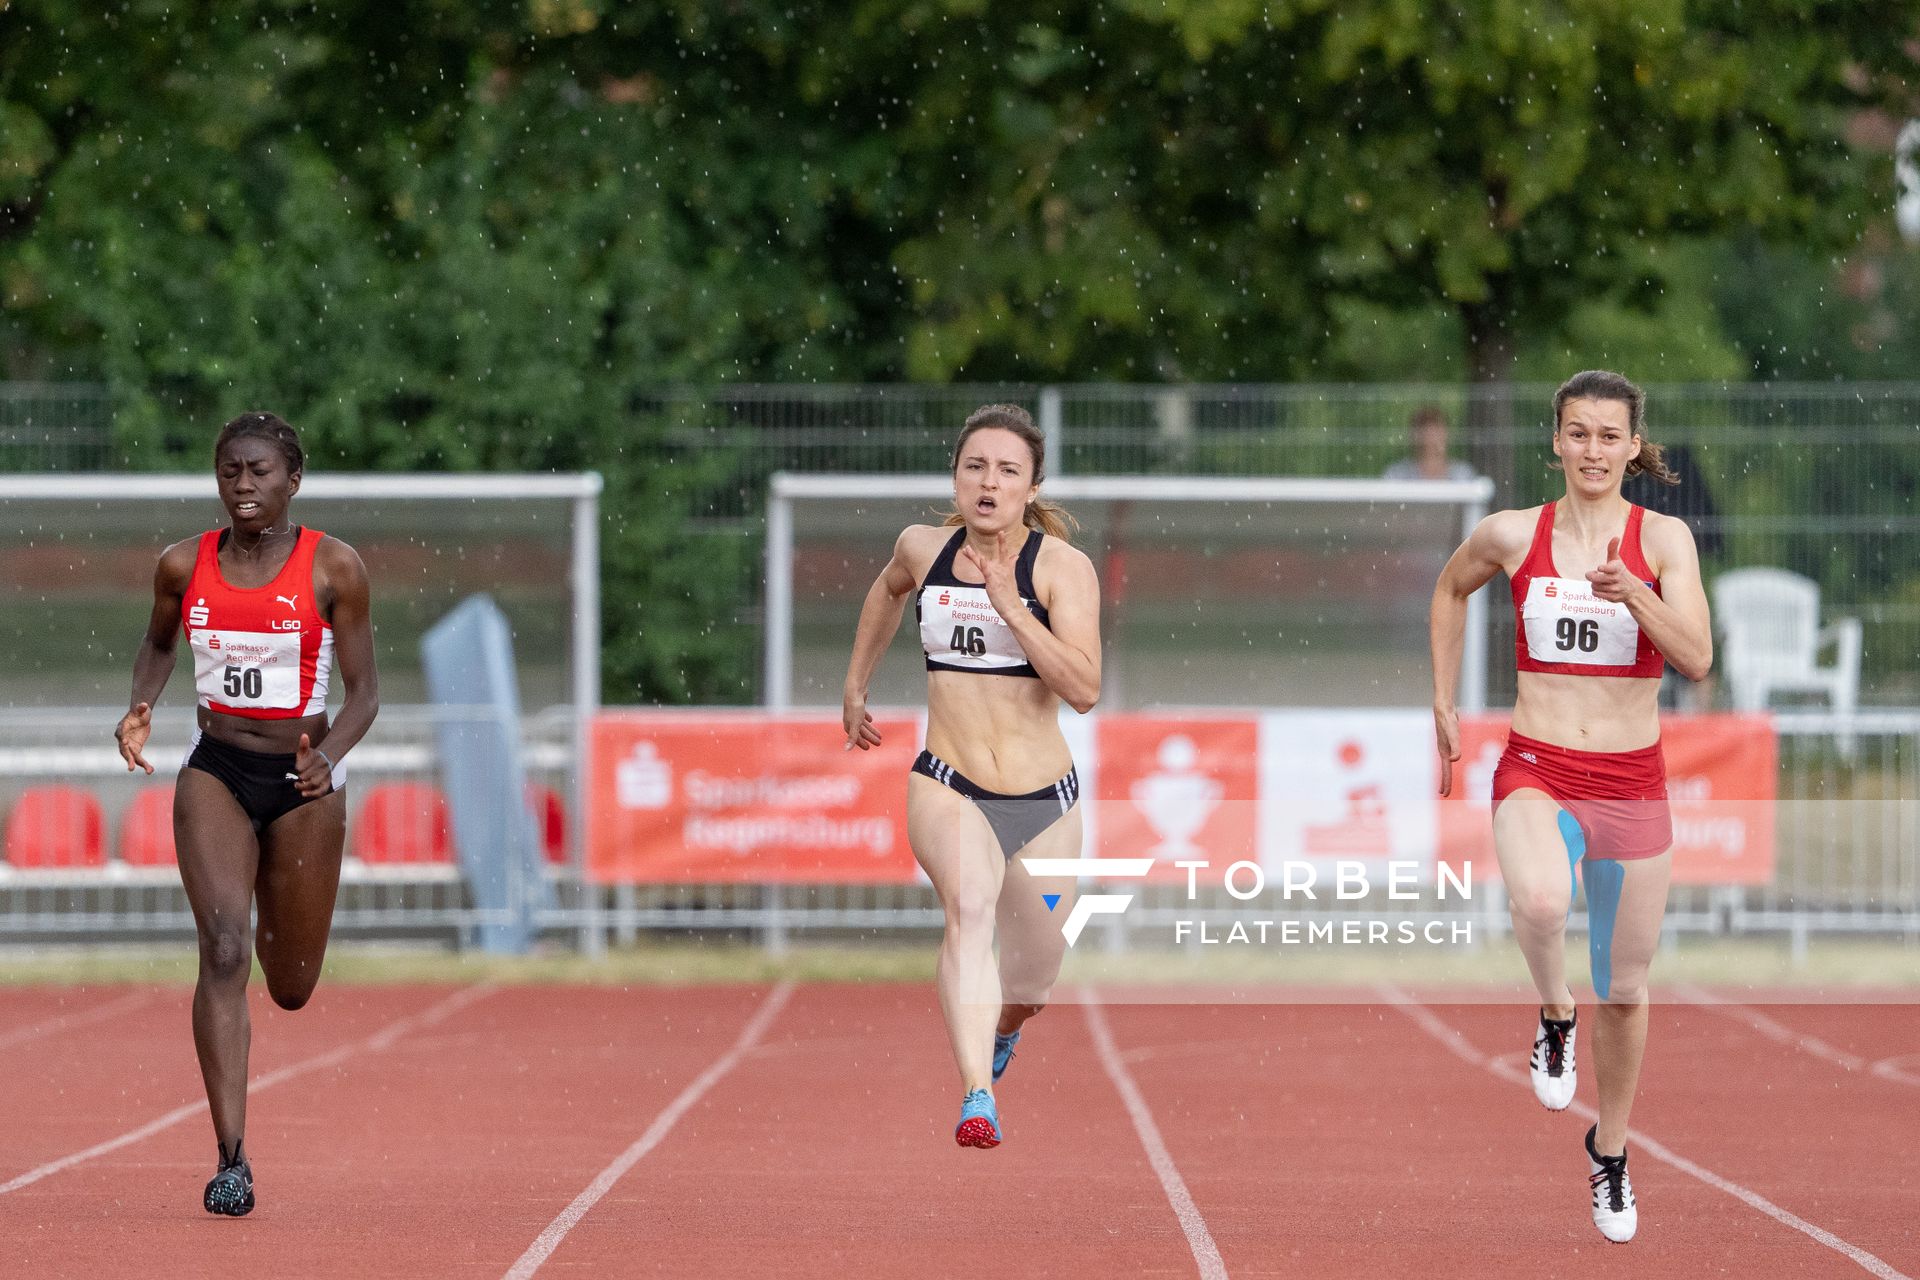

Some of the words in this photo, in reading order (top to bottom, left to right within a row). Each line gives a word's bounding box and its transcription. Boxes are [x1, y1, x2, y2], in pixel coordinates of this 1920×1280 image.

[951, 610, 1000, 624] Regensburg
[1561, 603, 1616, 617] Regensburg
[272, 620, 301, 630] LGO
[950, 625, 987, 657] 46
[1555, 617, 1599, 653] 96
[225, 643, 270, 653] Sparkasse
[226, 654, 278, 663] Regensburg
[223, 665, 263, 699] 50
